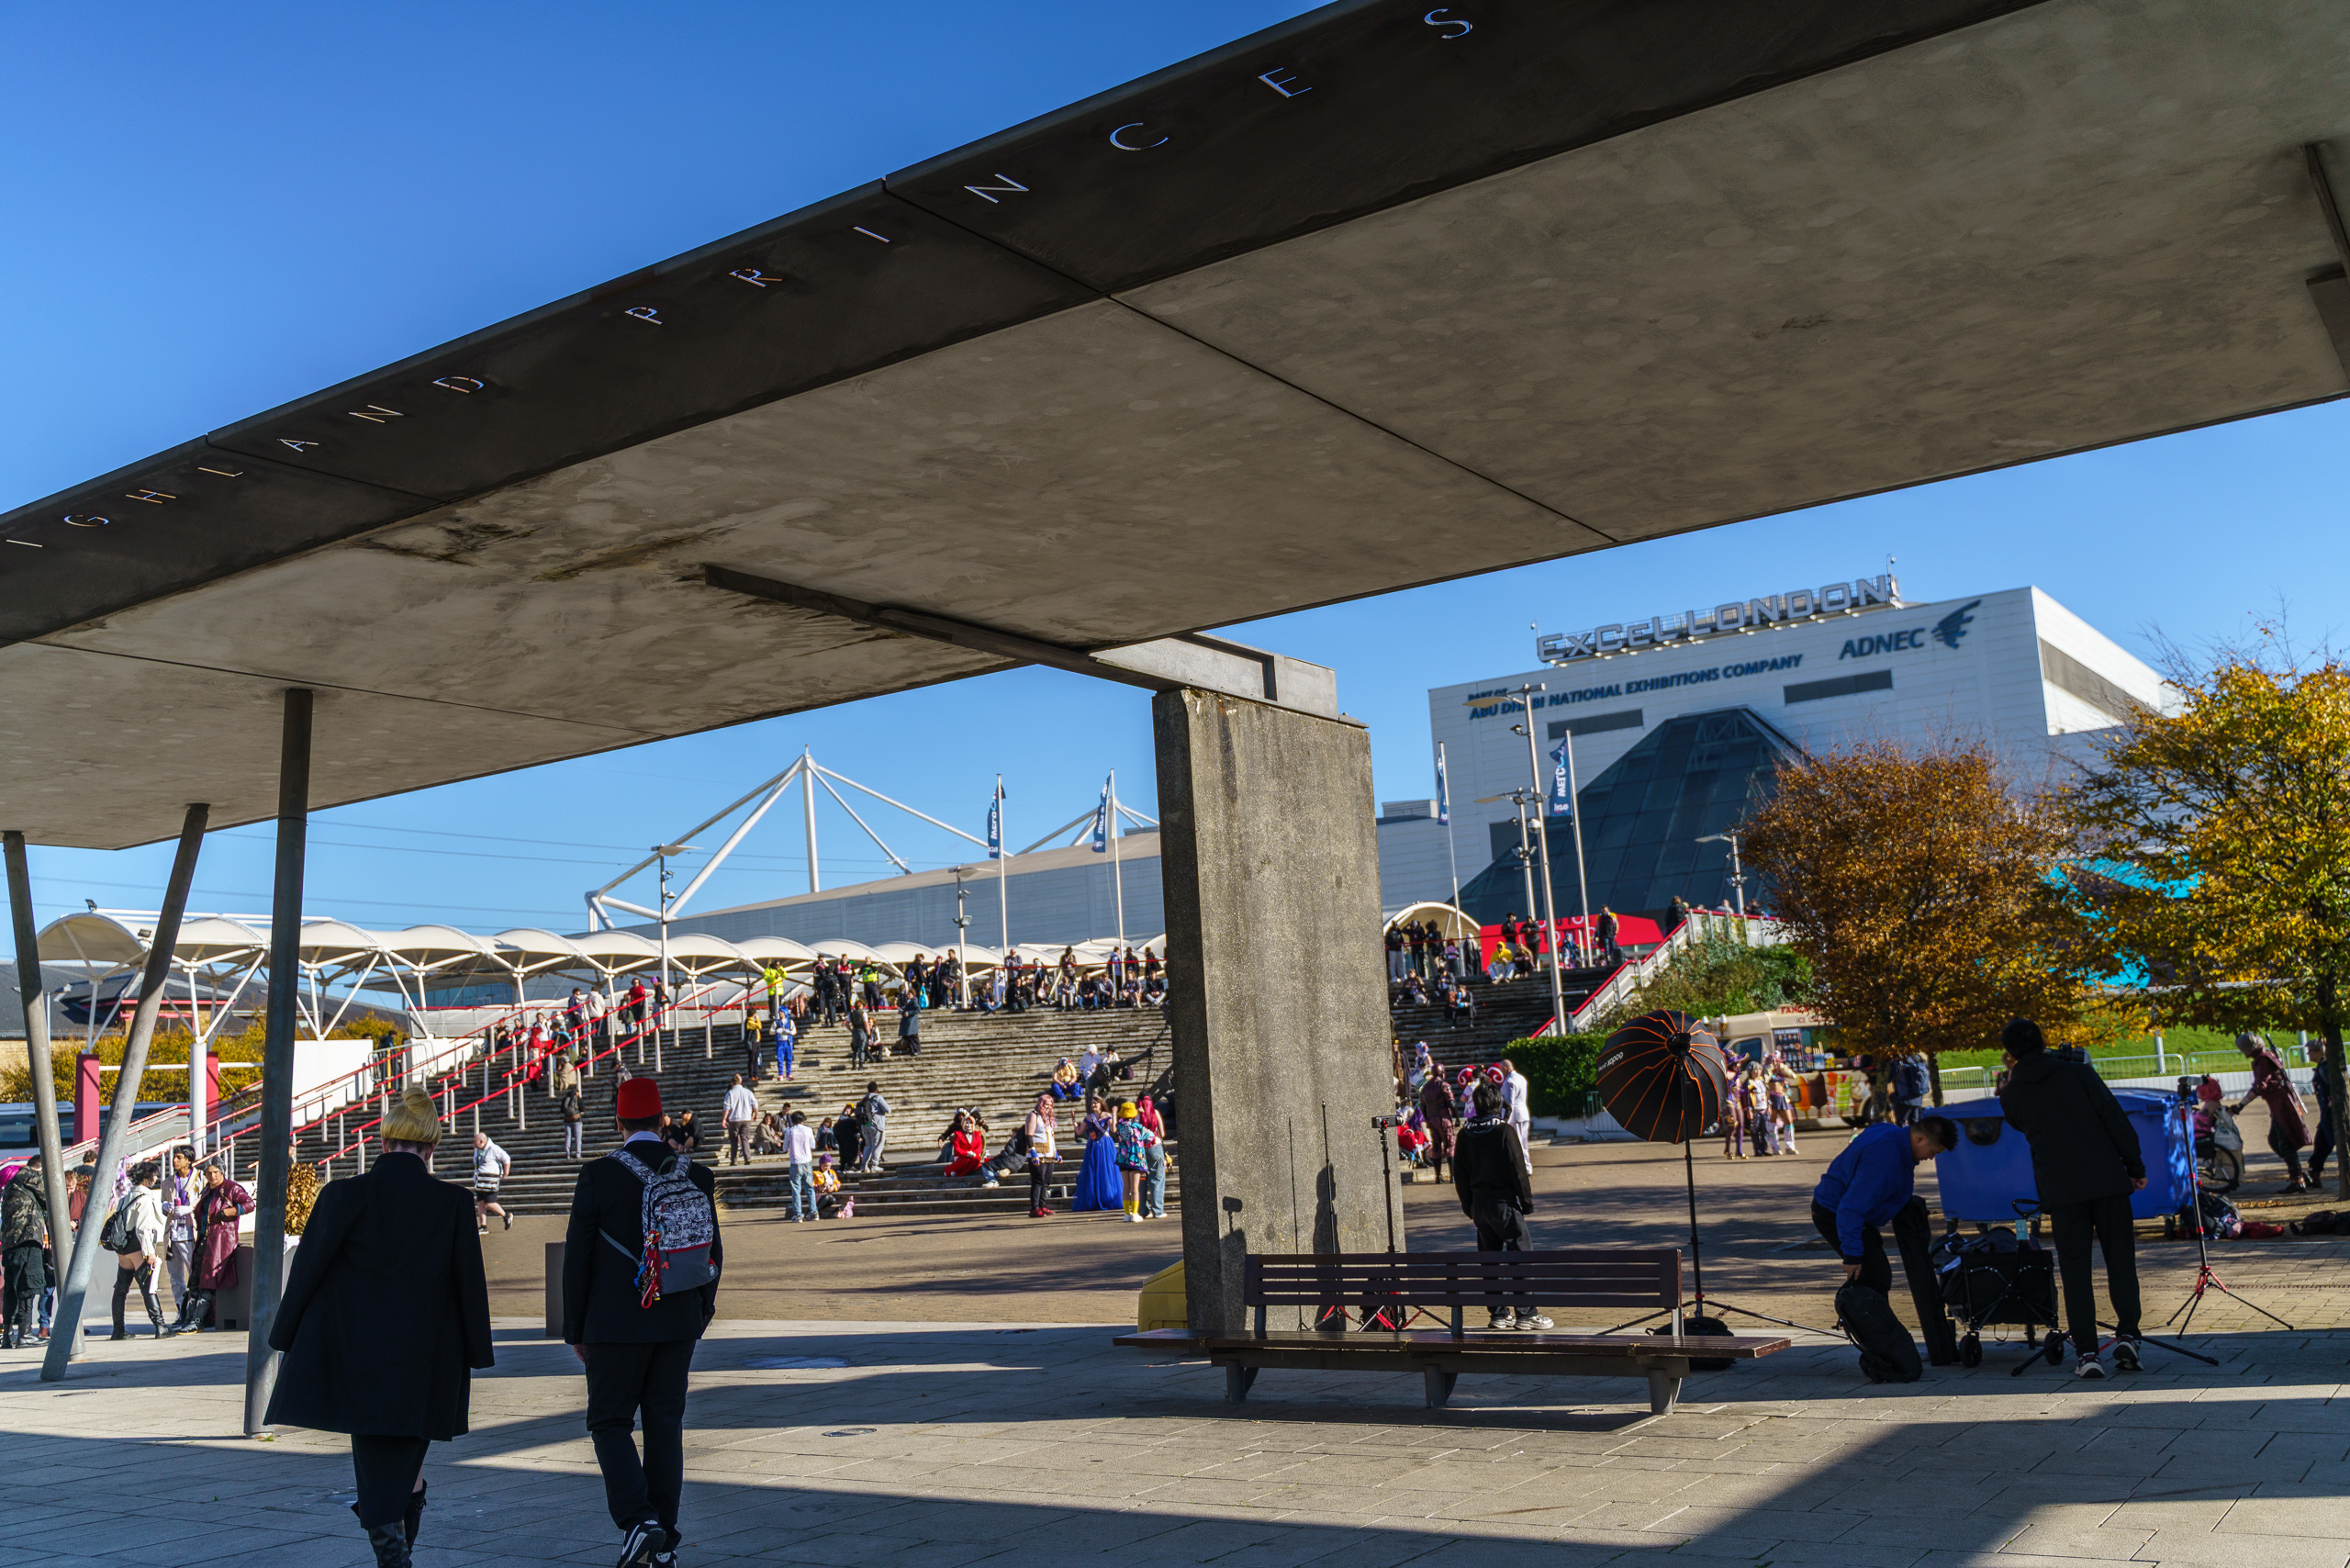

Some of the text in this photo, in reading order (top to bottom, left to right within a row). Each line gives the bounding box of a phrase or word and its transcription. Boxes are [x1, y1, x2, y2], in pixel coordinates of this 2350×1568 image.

[1684, 574, 1889, 637] LONDON
[1838, 627, 1926, 660] ADNEC
[1548, 683, 1622, 707] NATIONAL
[1625, 666, 1719, 694] EXHIBITIONS
[1722, 654, 1804, 680] COMPANY
